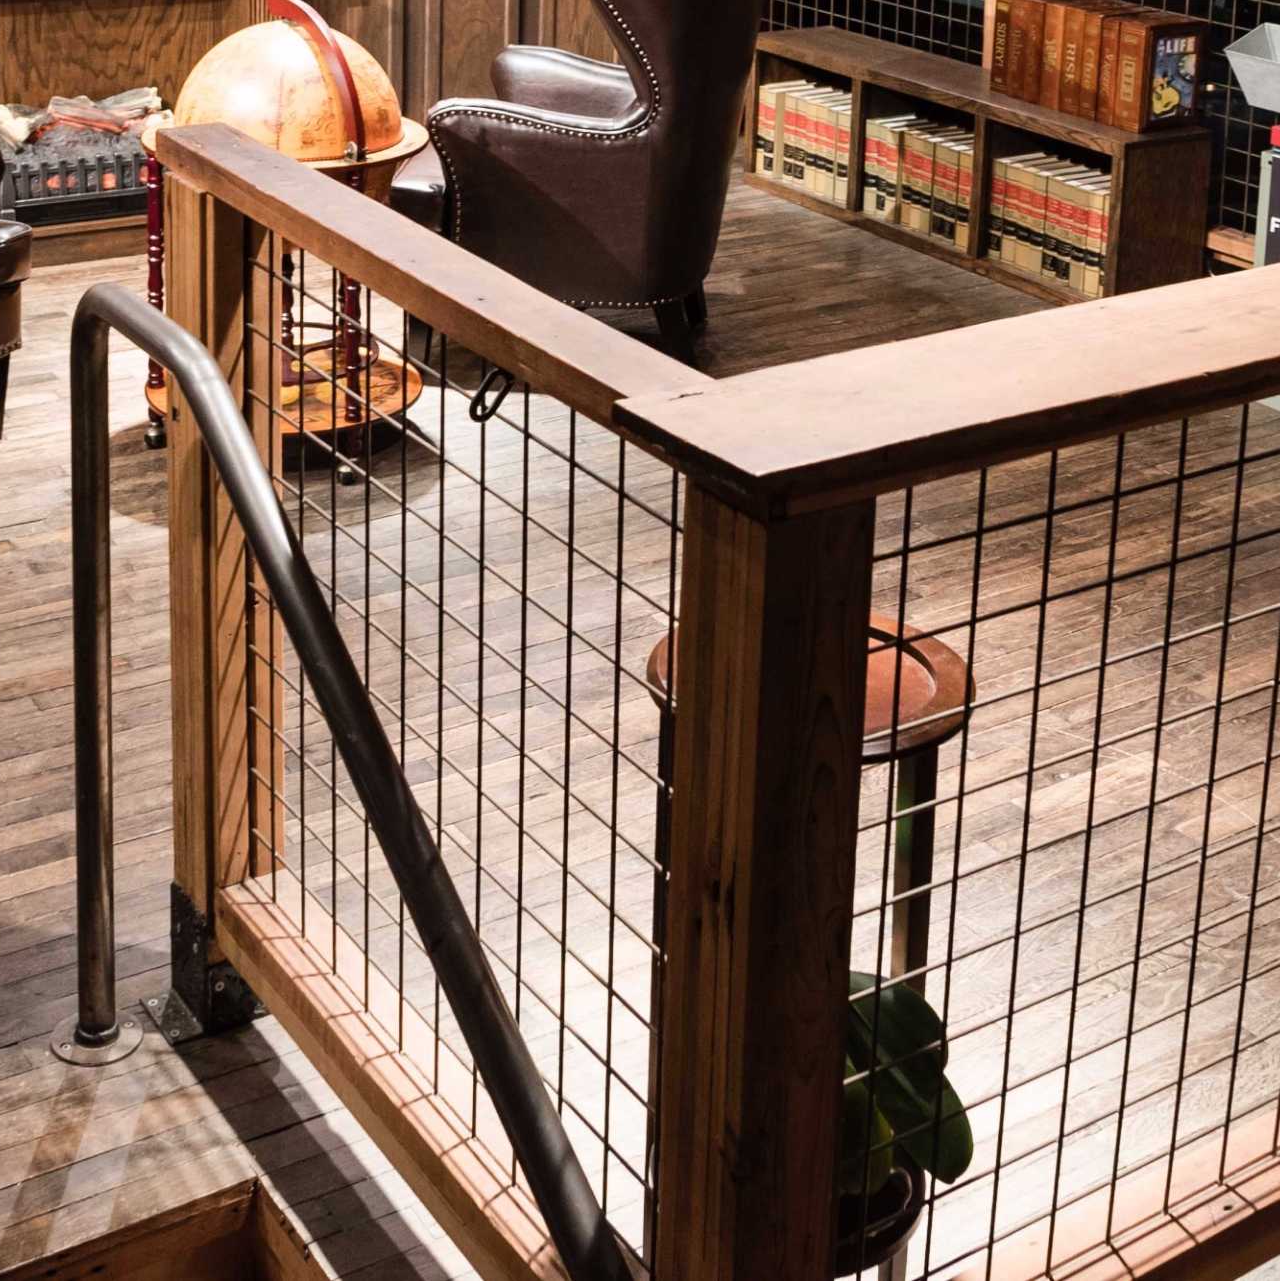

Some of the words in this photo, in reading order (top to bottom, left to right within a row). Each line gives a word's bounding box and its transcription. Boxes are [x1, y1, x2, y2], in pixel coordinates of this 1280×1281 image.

[994, 21, 1007, 68] SORRY!
[1064, 43, 1077, 84] RISK
[1165, 36, 1196, 53] LIFE
[1122, 61, 1134, 99] LIFE
